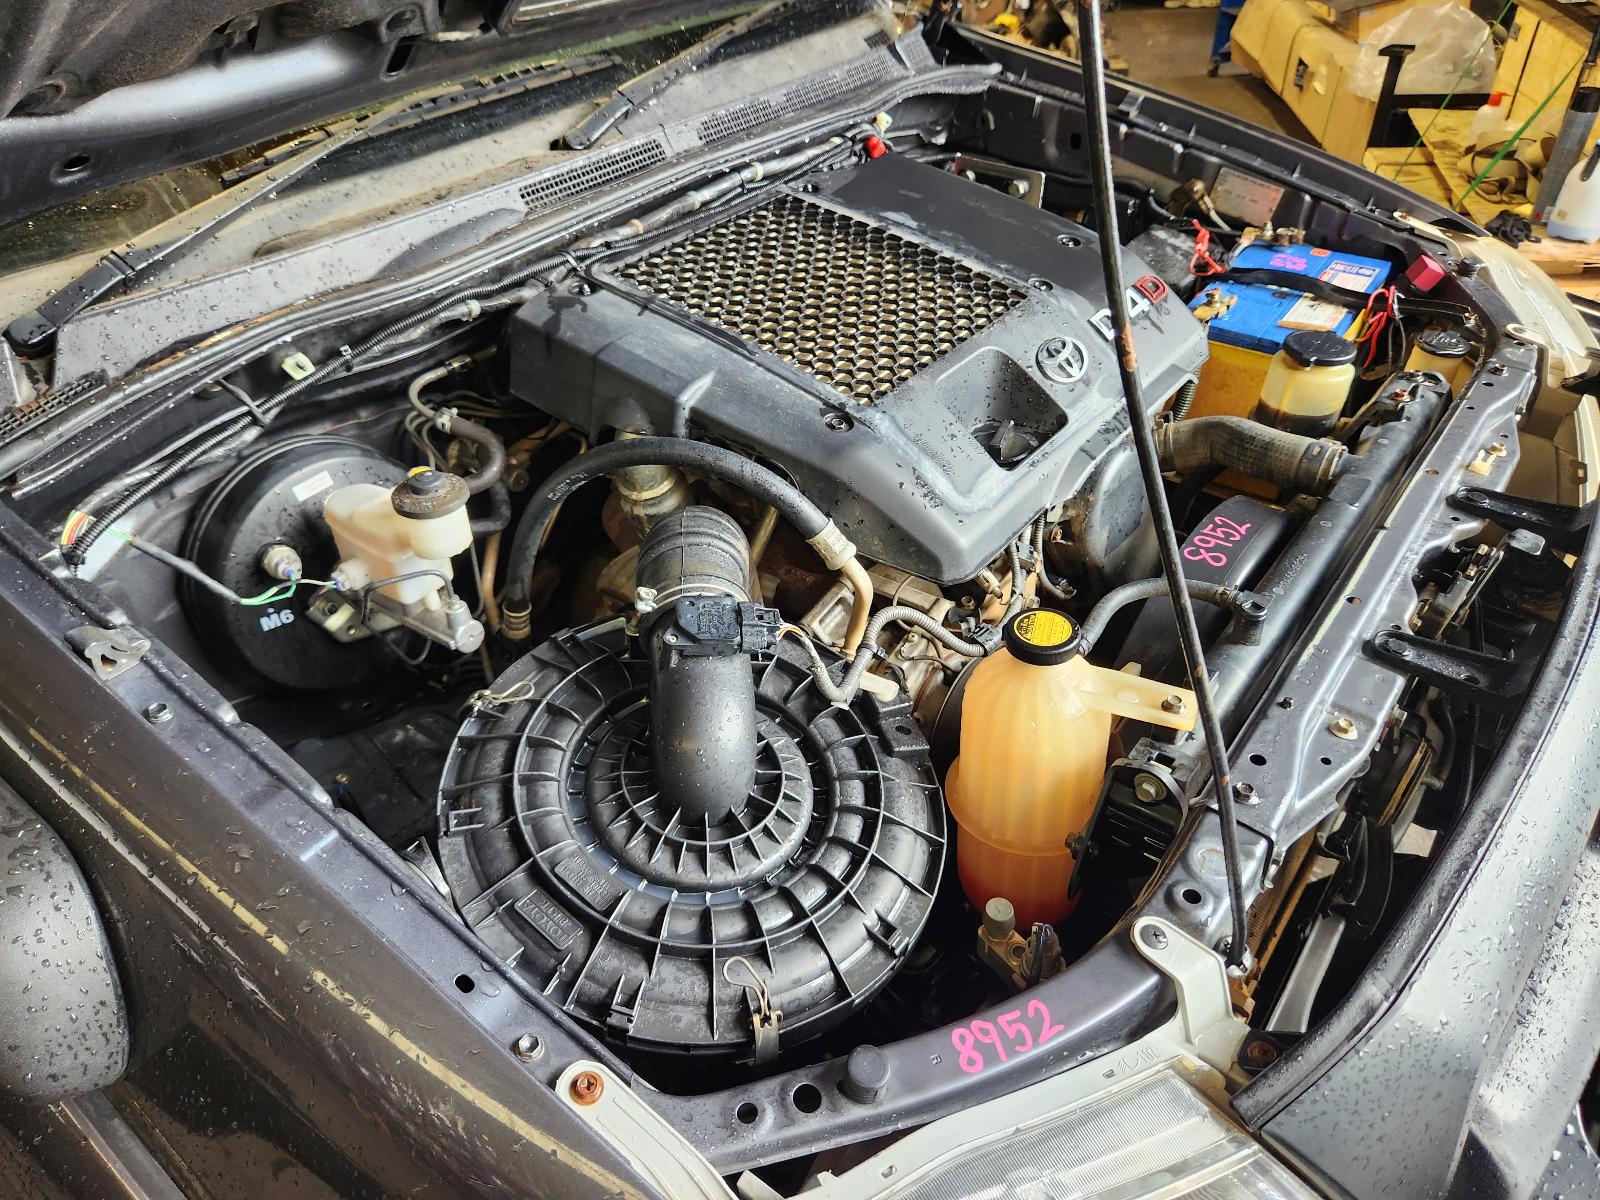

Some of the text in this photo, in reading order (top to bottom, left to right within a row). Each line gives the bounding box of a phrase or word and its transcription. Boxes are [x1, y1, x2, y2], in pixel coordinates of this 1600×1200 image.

[1183, 516, 1252, 567] 8952
[260, 608, 295, 632] M6
[520, 898, 569, 943] TOYOTA
[951, 1000, 1065, 1074] 8952
